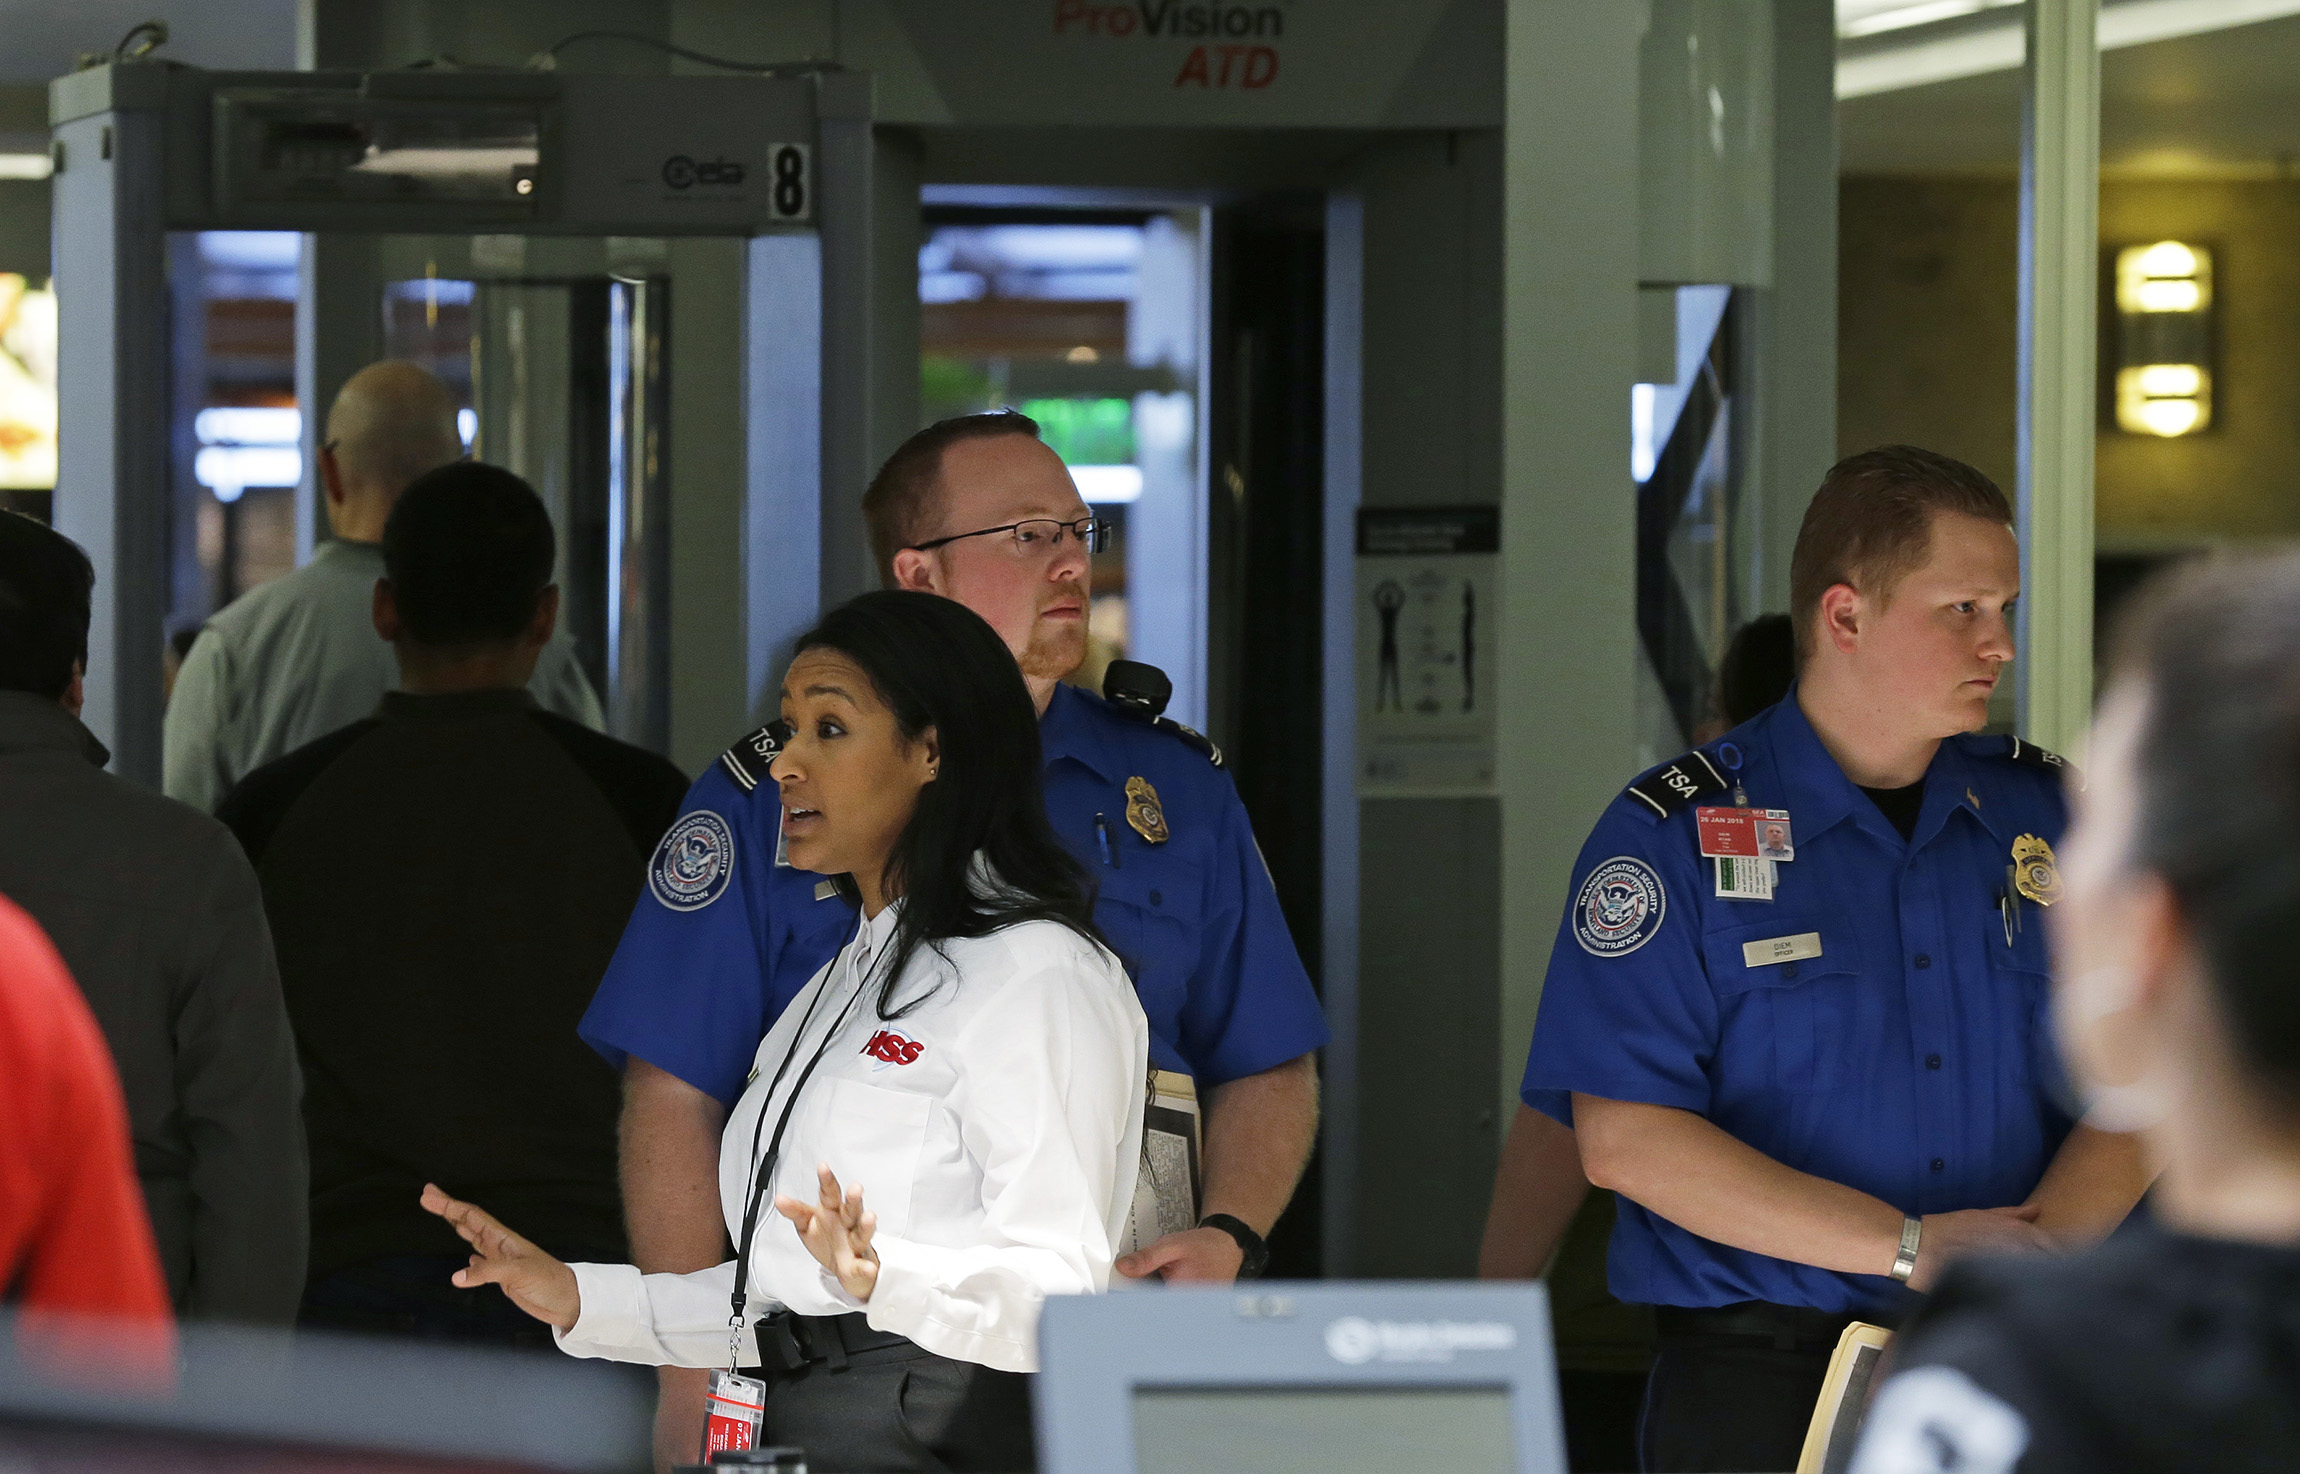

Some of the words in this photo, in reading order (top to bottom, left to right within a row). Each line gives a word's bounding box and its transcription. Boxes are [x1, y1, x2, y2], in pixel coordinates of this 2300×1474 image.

[1053, 0, 1284, 36] ProVision
[1175, 45, 1281, 89] ATD
[775, 146, 804, 216] 8
[749, 727, 781, 763] TSA
[1661, 765, 1698, 799] TSA
[664, 817, 720, 849] TRANSPORTATION
[1580, 863, 1642, 907] TRANSPORTATION
[1639, 873, 1659, 914] SECURITY
[1580, 926, 1642, 950] ADMINISTRATION
[859, 1029, 925, 1066] HSS
[737, 1422, 743, 1433] 07
